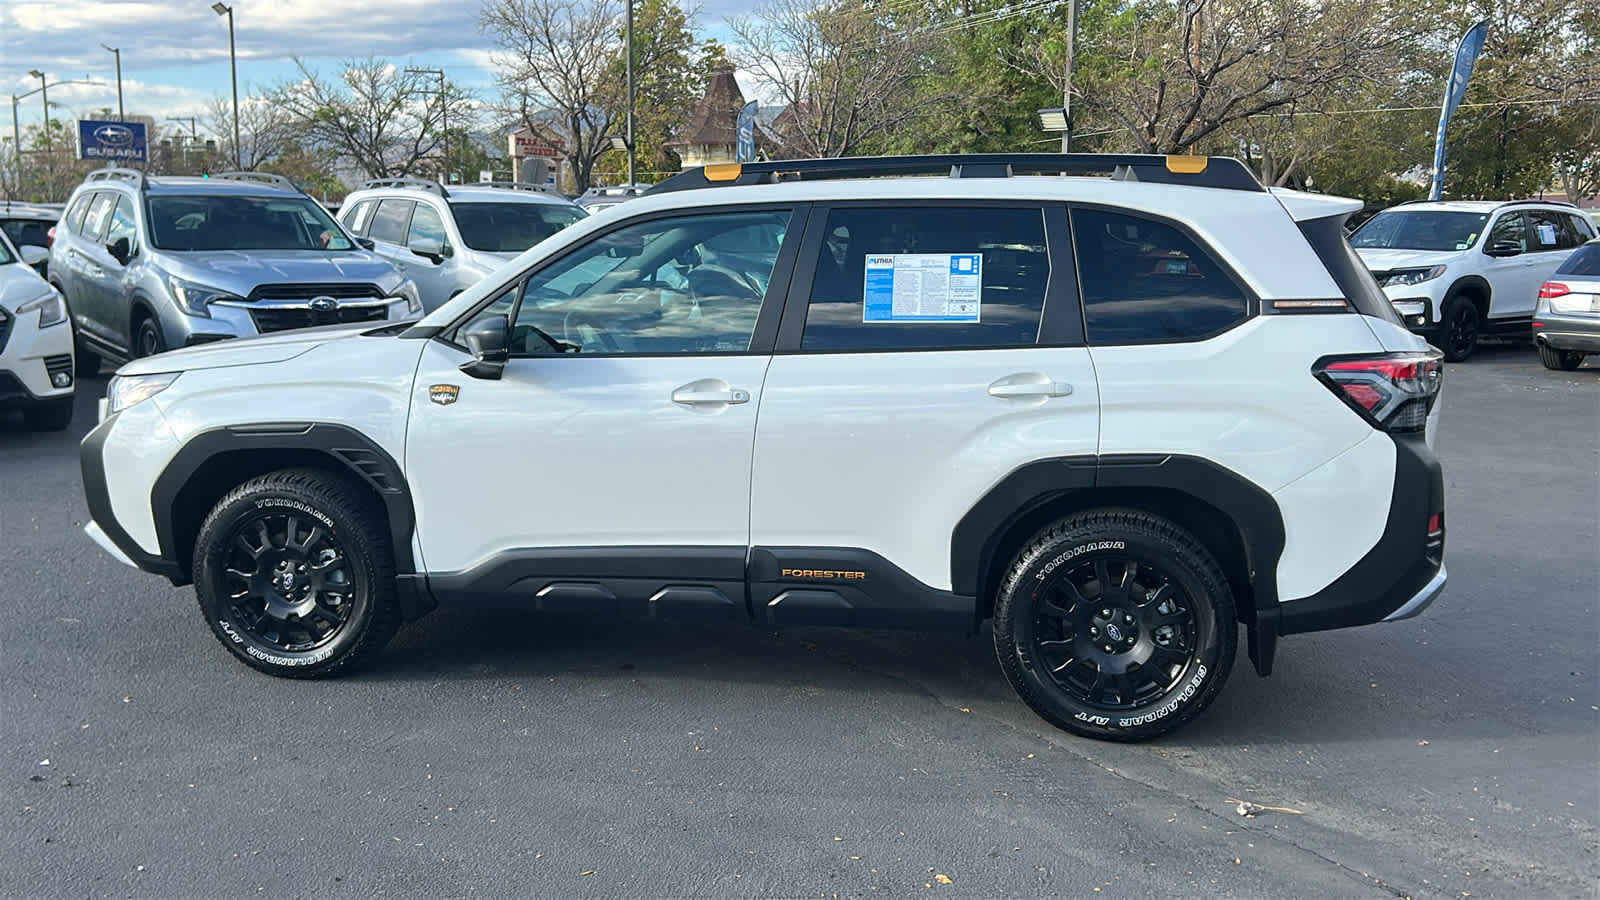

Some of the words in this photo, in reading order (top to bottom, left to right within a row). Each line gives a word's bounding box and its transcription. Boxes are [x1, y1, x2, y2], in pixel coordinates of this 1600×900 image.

[86, 147, 143, 158] SUBARU
[255, 498, 334, 528] YOKOHAMA
[1035, 540, 1125, 582] YOKOHAMA
[781, 568, 866, 580] FORESTER
[219, 619, 244, 644] A/T
[1119, 665, 1208, 728] GEOLANDAR
[1074, 711, 1110, 726] A/T
